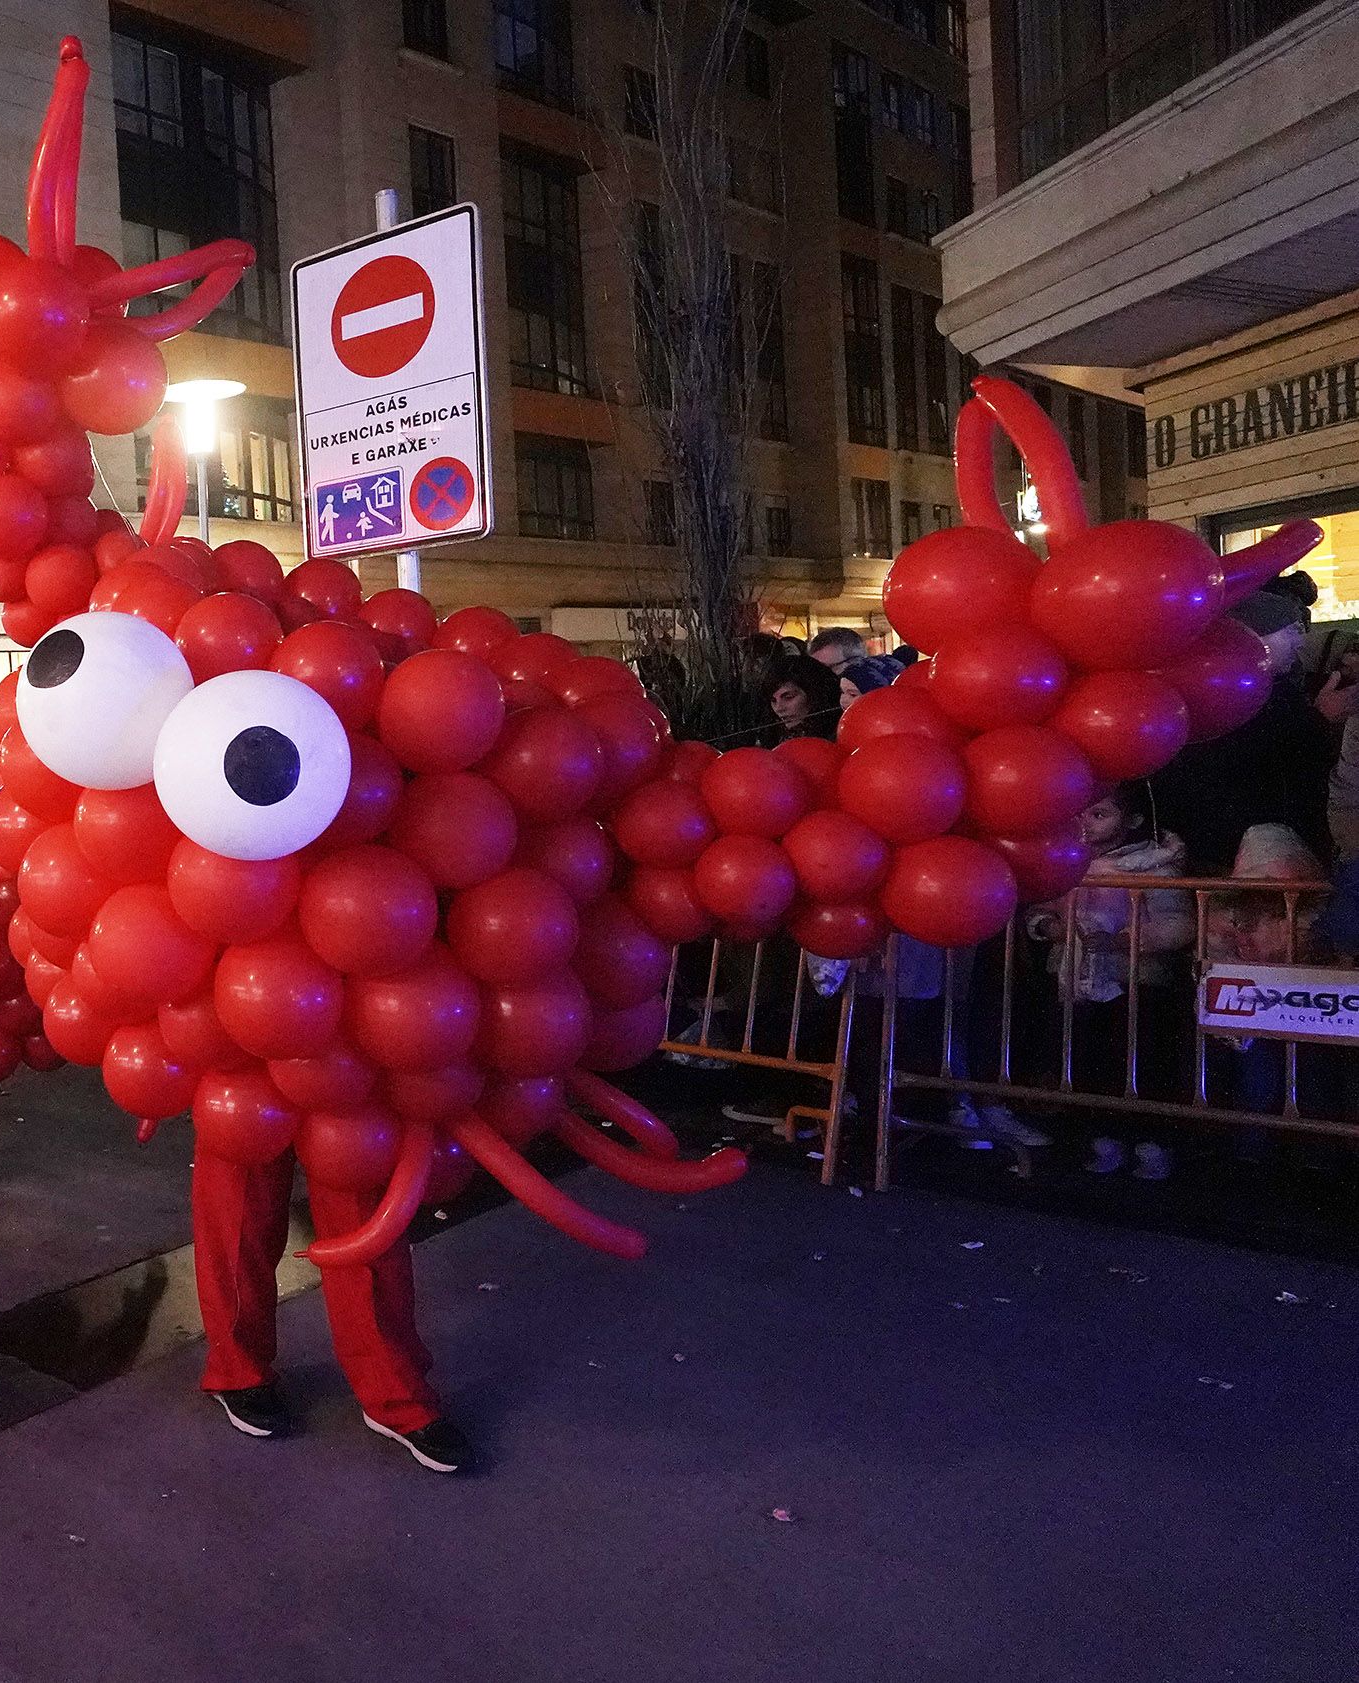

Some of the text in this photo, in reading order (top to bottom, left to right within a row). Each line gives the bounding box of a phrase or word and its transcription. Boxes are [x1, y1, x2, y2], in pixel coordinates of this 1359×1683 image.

[365, 395, 408, 417] AGÁS
[310, 402, 472, 451] URXENCIAS MÉDICAS
[1154, 414, 1176, 467] O
[351, 437, 428, 466] E GARAXE
[1279, 1014, 1355, 1025] ALQUILER
